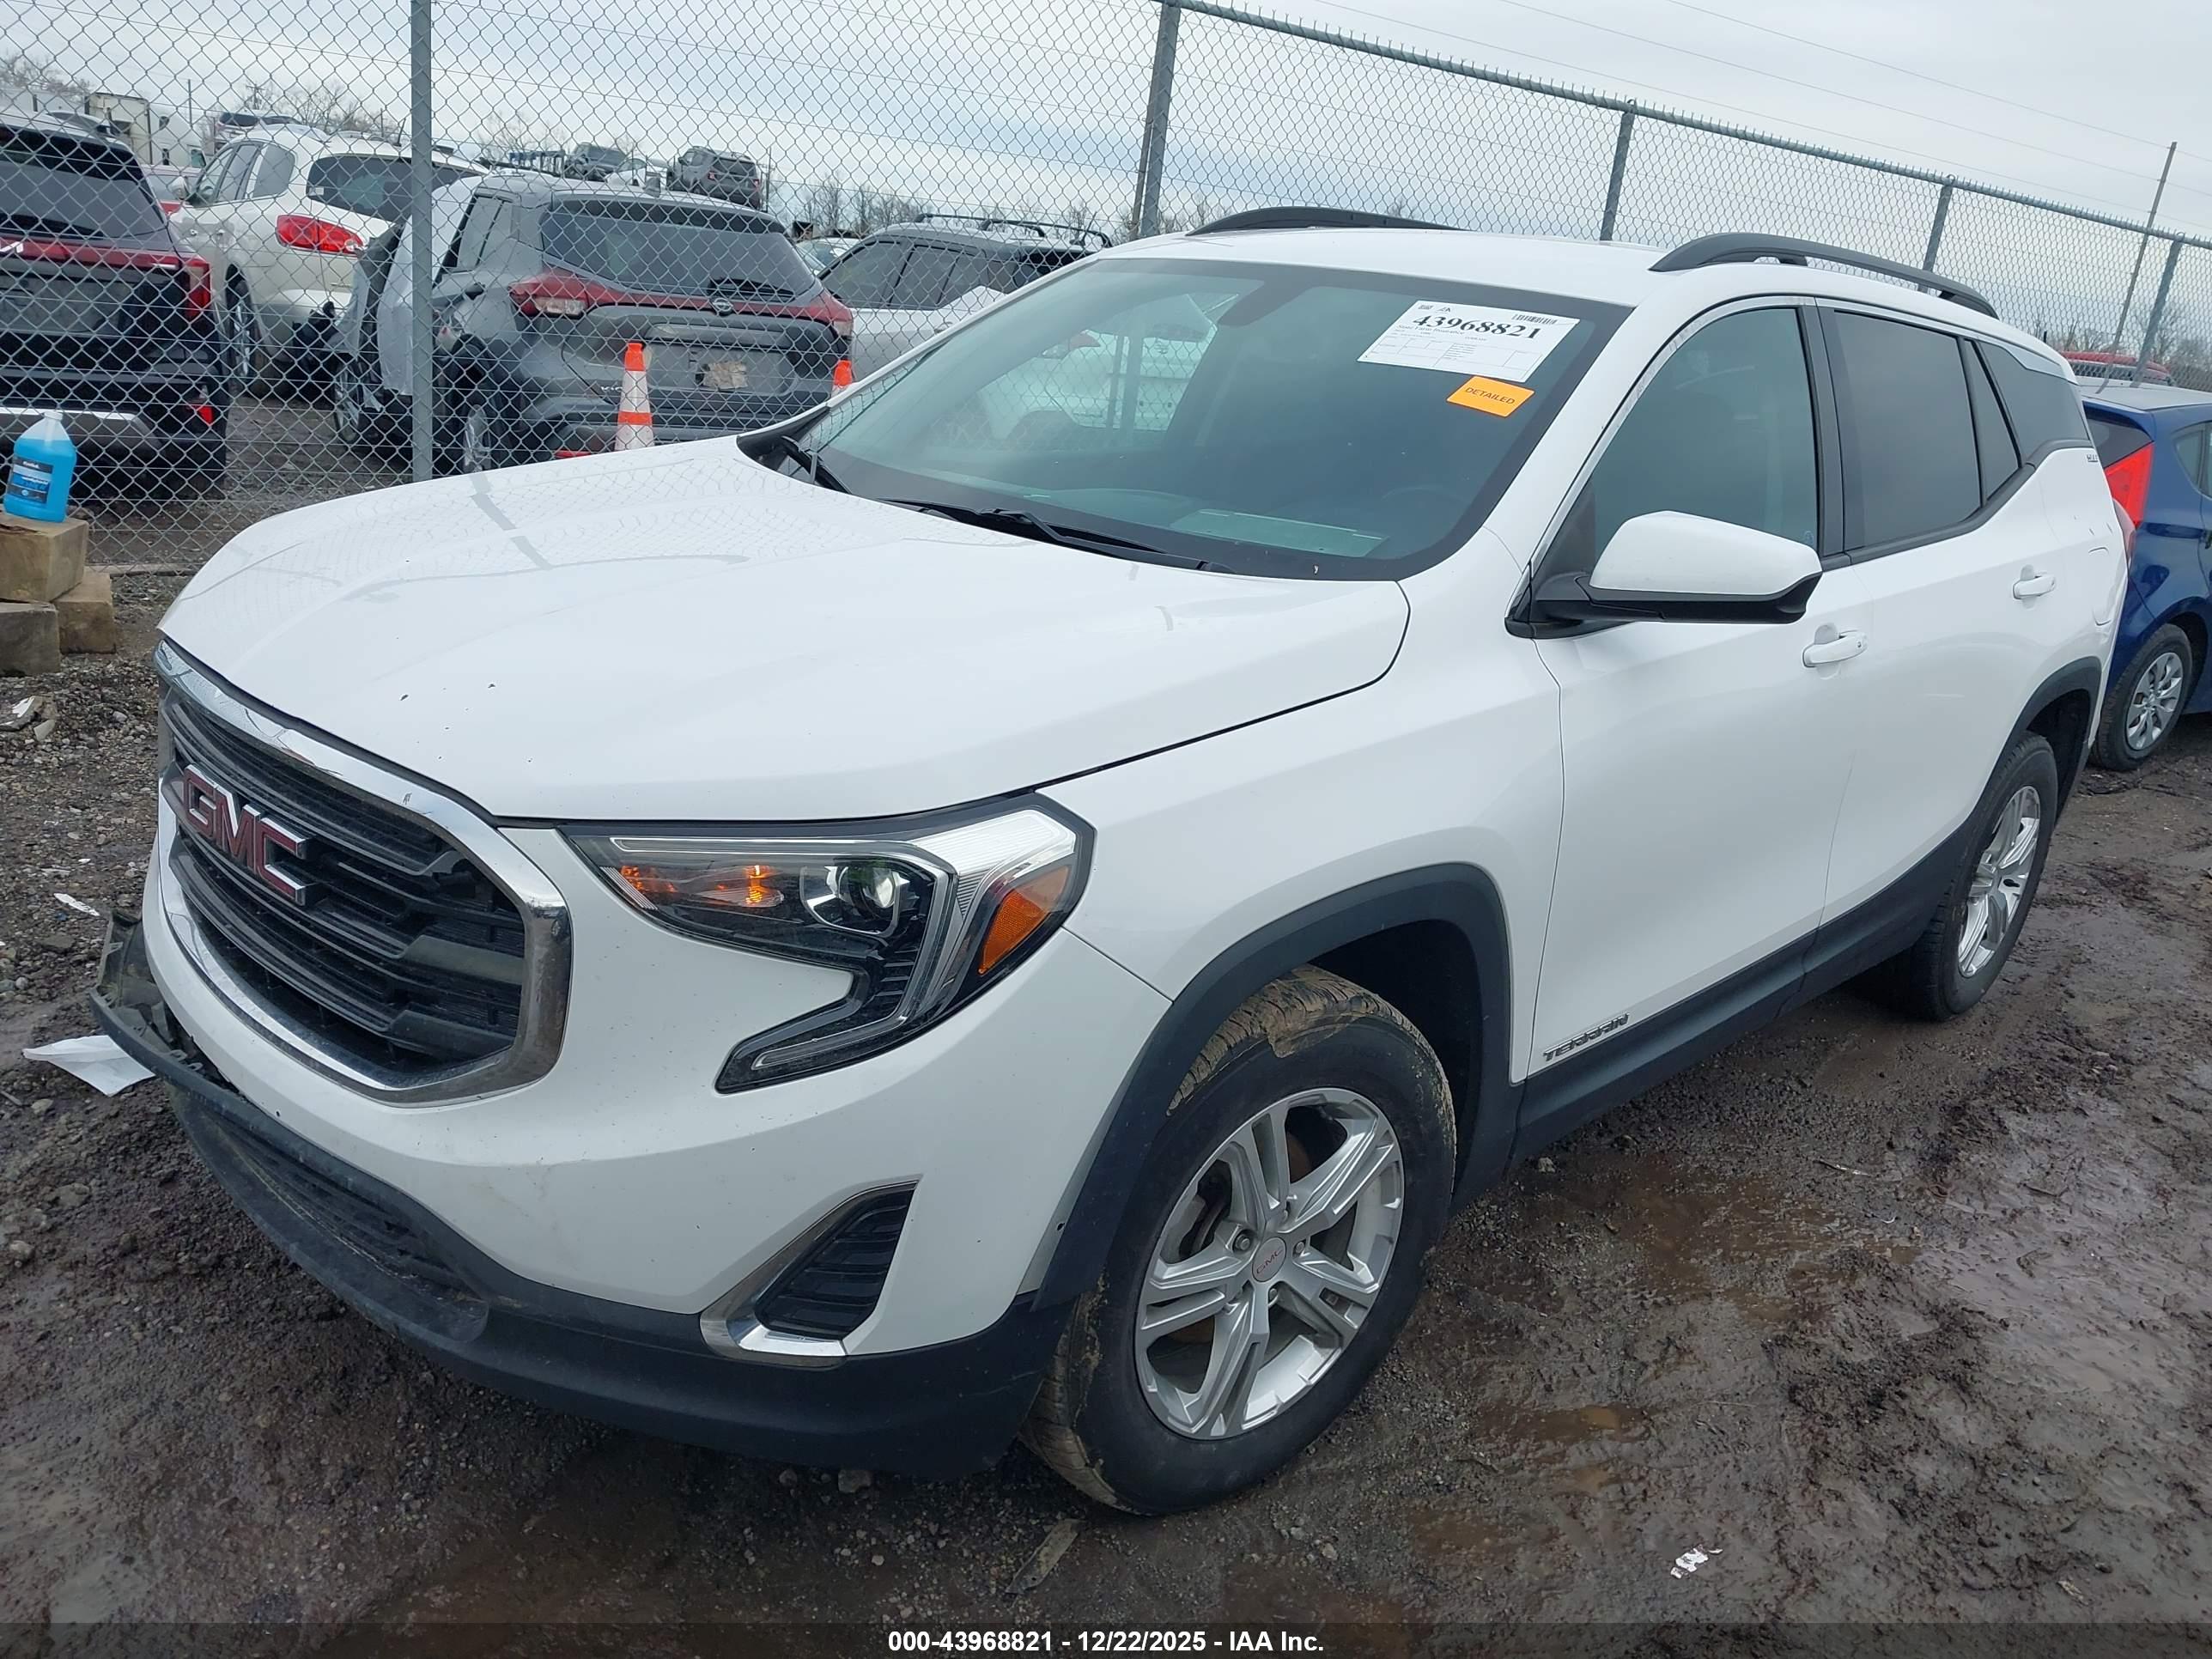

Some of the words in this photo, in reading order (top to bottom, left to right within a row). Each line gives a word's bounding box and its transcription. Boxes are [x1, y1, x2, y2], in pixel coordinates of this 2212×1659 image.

[1413, 314, 1541, 339] 43968821
[1465, 386, 1516, 404] DETAILED
[184, 764, 306, 906] GMC
[1543, 1012, 1630, 1061] TERRAIN
[1256, 1249, 1283, 1274] GMC
